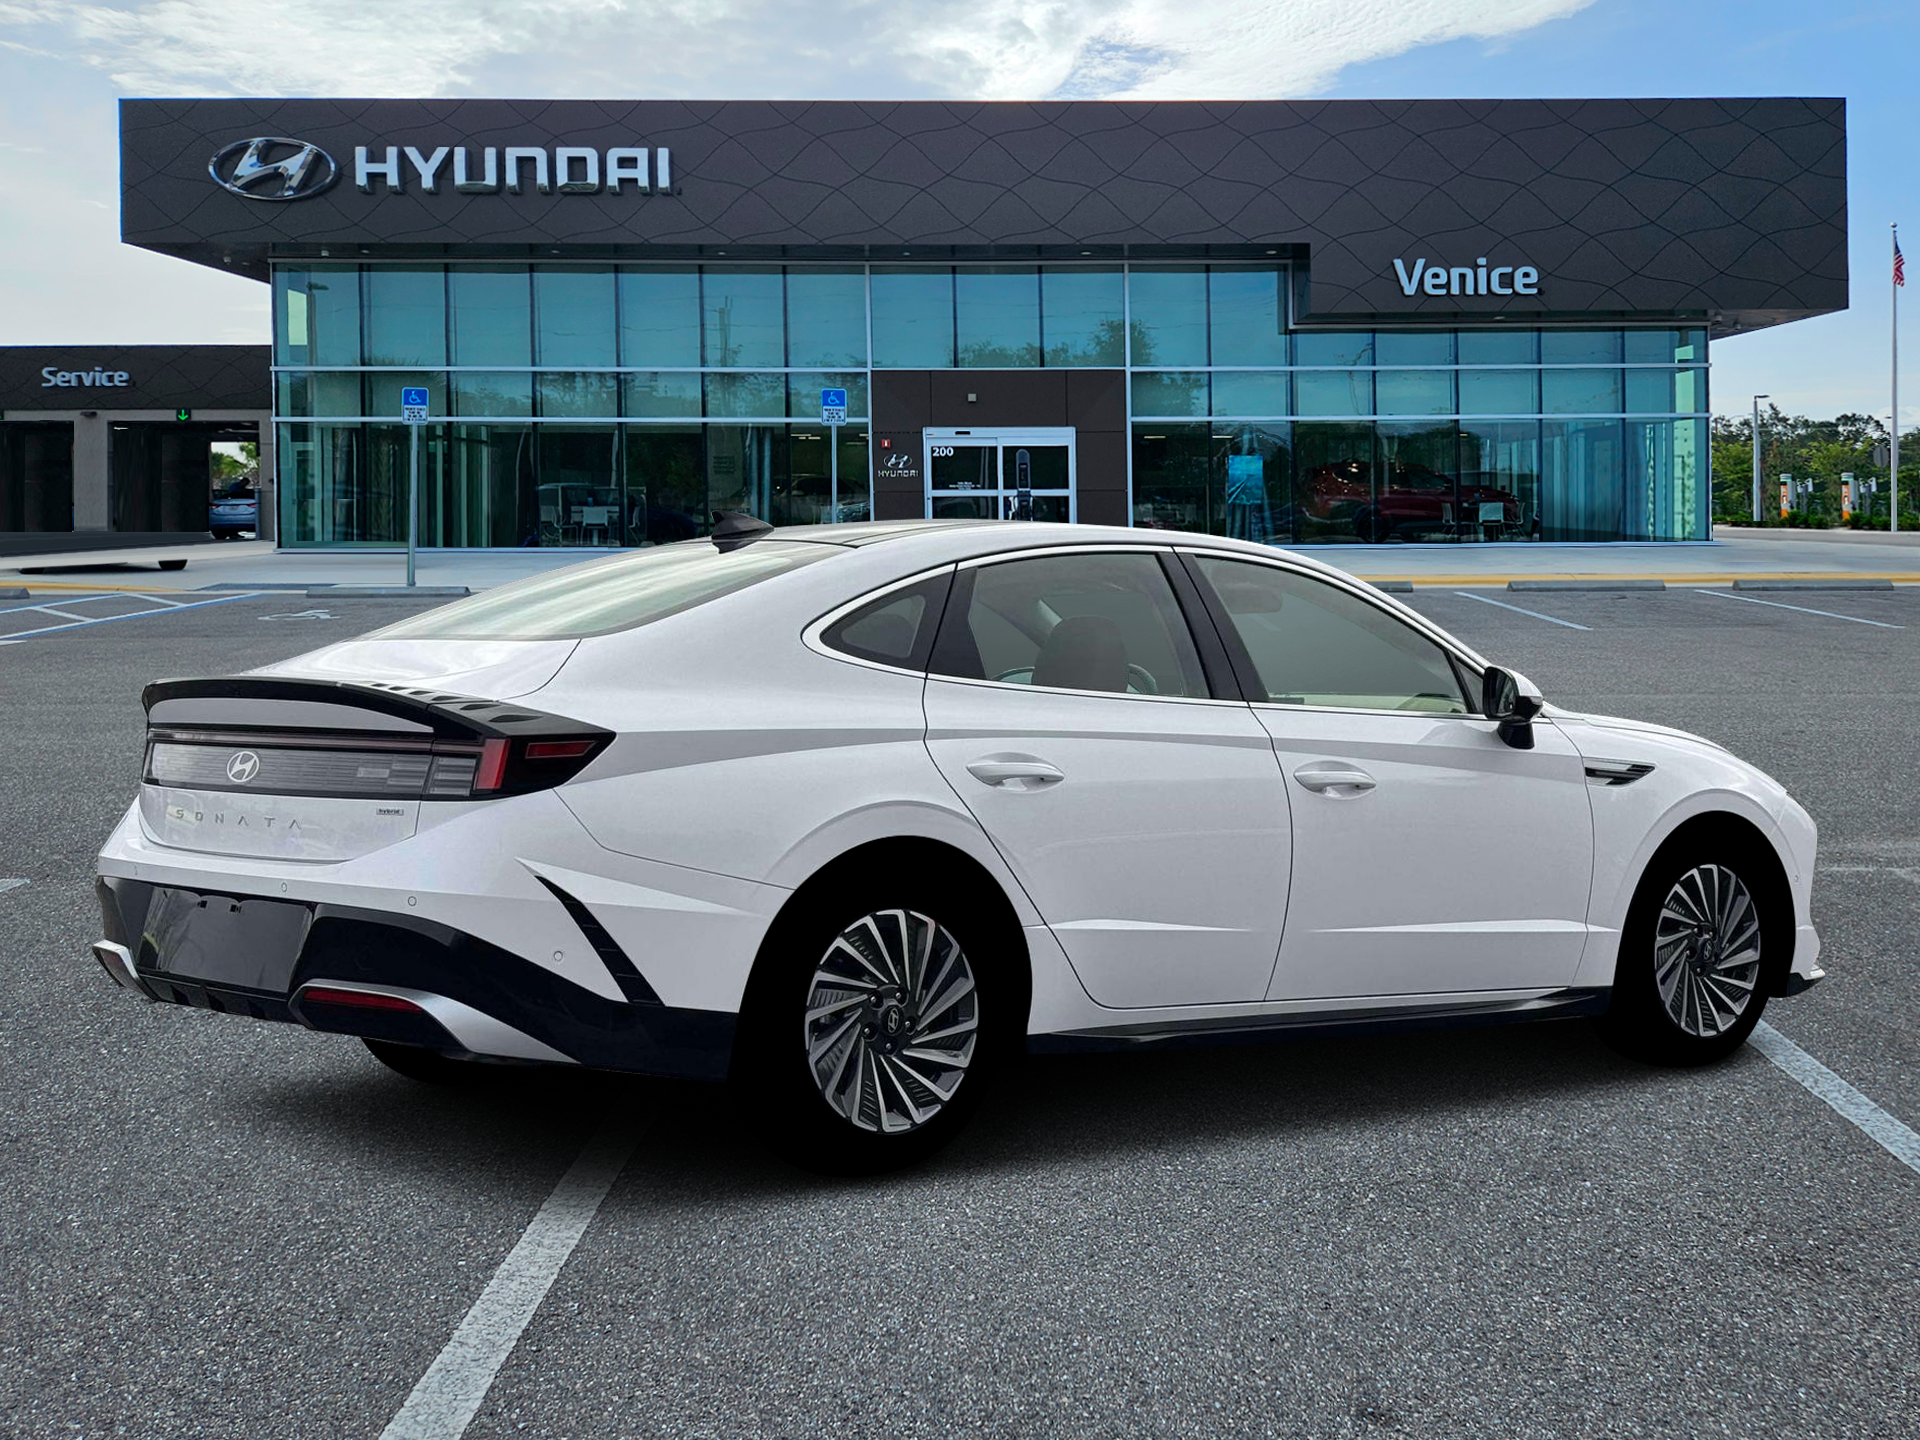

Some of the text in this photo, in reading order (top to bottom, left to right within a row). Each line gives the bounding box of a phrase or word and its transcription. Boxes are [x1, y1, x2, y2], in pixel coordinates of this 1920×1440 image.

[354, 146, 670, 194] HYUNDAI
[1392, 256, 1539, 296] Venice
[41, 366, 130, 387] Service
[932, 446, 954, 457] 200
[877, 469, 919, 478] HYUNDAI
[175, 808, 303, 830] SONATA
